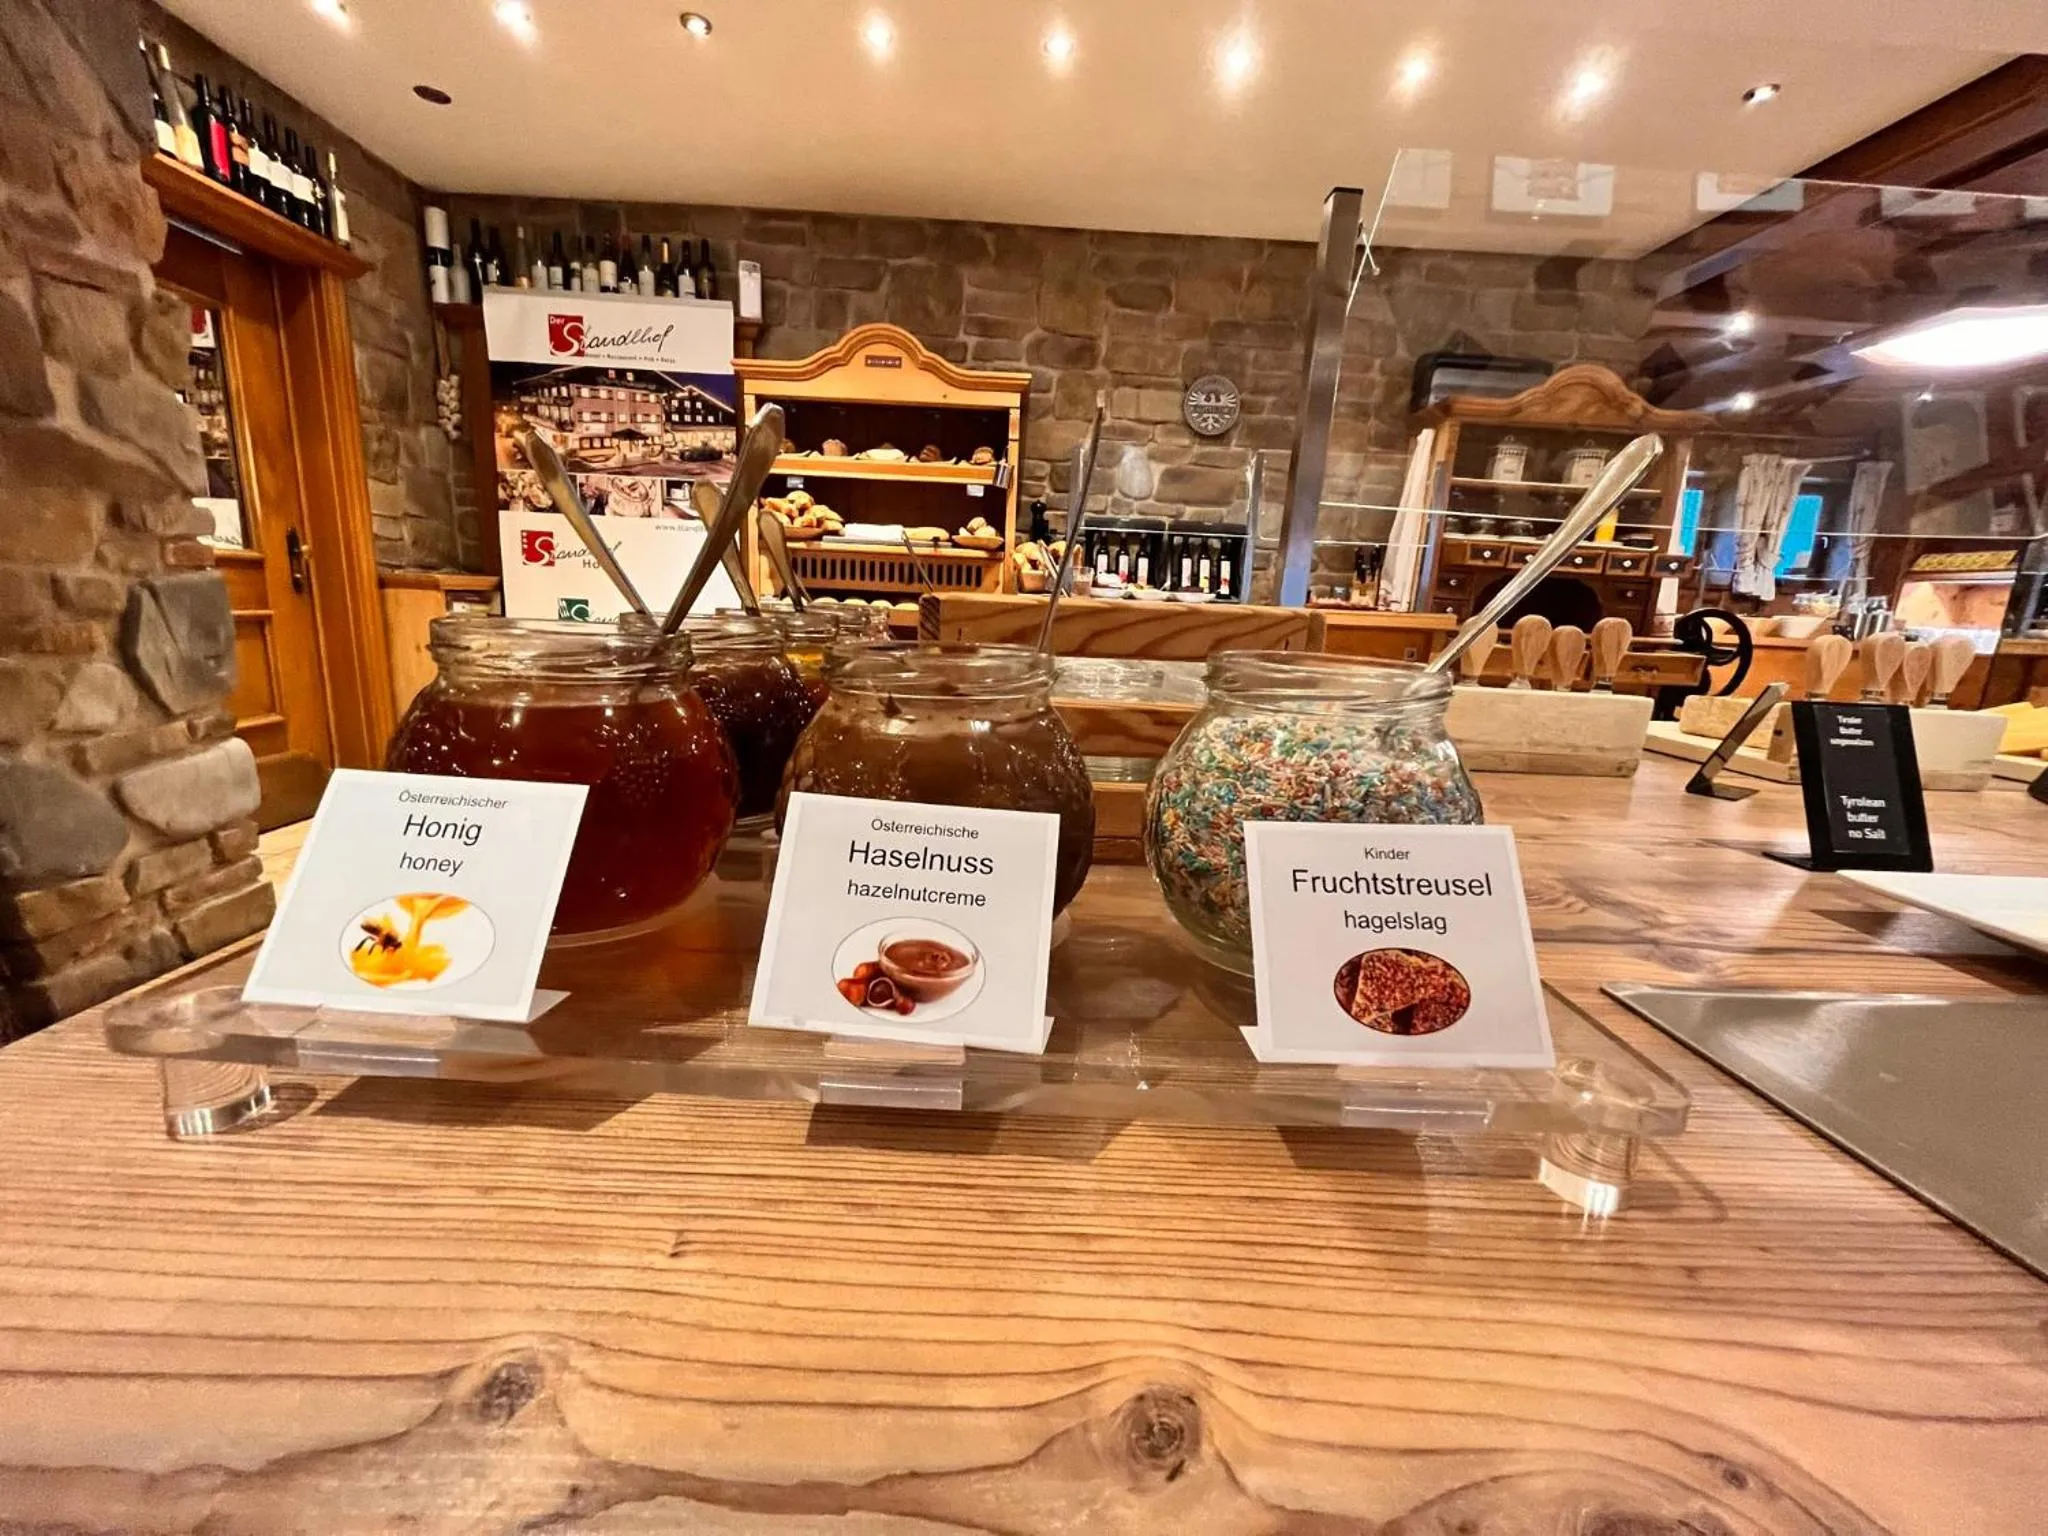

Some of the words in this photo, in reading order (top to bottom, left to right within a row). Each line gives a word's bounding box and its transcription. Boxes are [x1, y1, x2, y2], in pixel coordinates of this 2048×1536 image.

[1840, 795, 1887, 808] Tyrolean
[403, 813, 483, 847] Honig
[1846, 811, 1880, 823] butter
[1848, 829, 1863, 838] no
[1864, 828, 1887, 839] Salt
[399, 851, 464, 878] honey
[848, 840, 994, 876] Haselnuss
[1363, 846, 1411, 861] Kinder
[846, 879, 987, 908] hazelnutcreme
[1291, 868, 1493, 897] Fruchtstreusel
[1343, 909, 1448, 935] hagelslag
